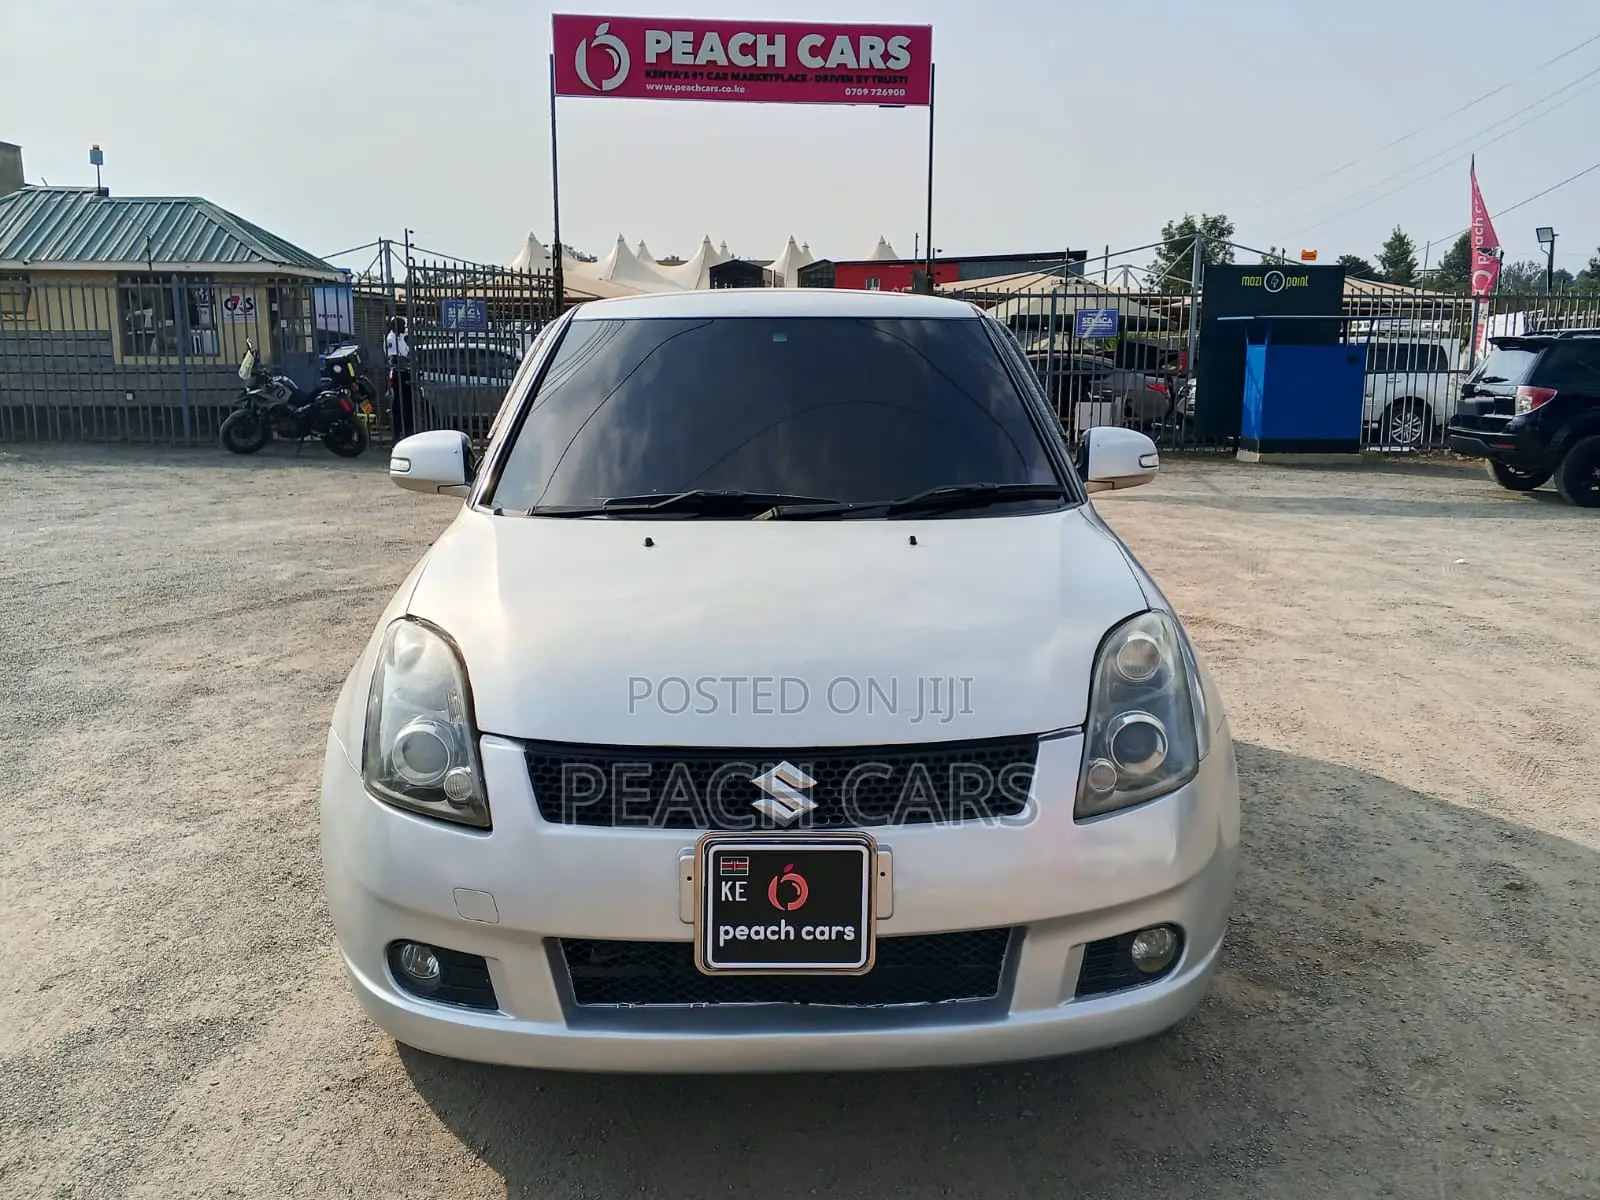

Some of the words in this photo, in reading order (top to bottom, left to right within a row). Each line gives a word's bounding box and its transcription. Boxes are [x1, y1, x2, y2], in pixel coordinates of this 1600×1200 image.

[645, 29, 786, 67] PEACH
[797, 34, 912, 71] CARS
[706, 72, 729, 81] CAR
[731, 73, 808, 83] MARKETPLACE
[815, 74, 853, 83] DRIVEN
[856, 75, 868, 83] BY
[646, 83, 746, 93] www.peachcars.co.ke
[845, 88, 868, 96] 0709
[871, 88, 906, 96] 726900
[1286, 275, 1309, 290] point
[721, 881, 747, 901] KE
[719, 919, 795, 947] peach
[801, 925, 855, 940] cars
